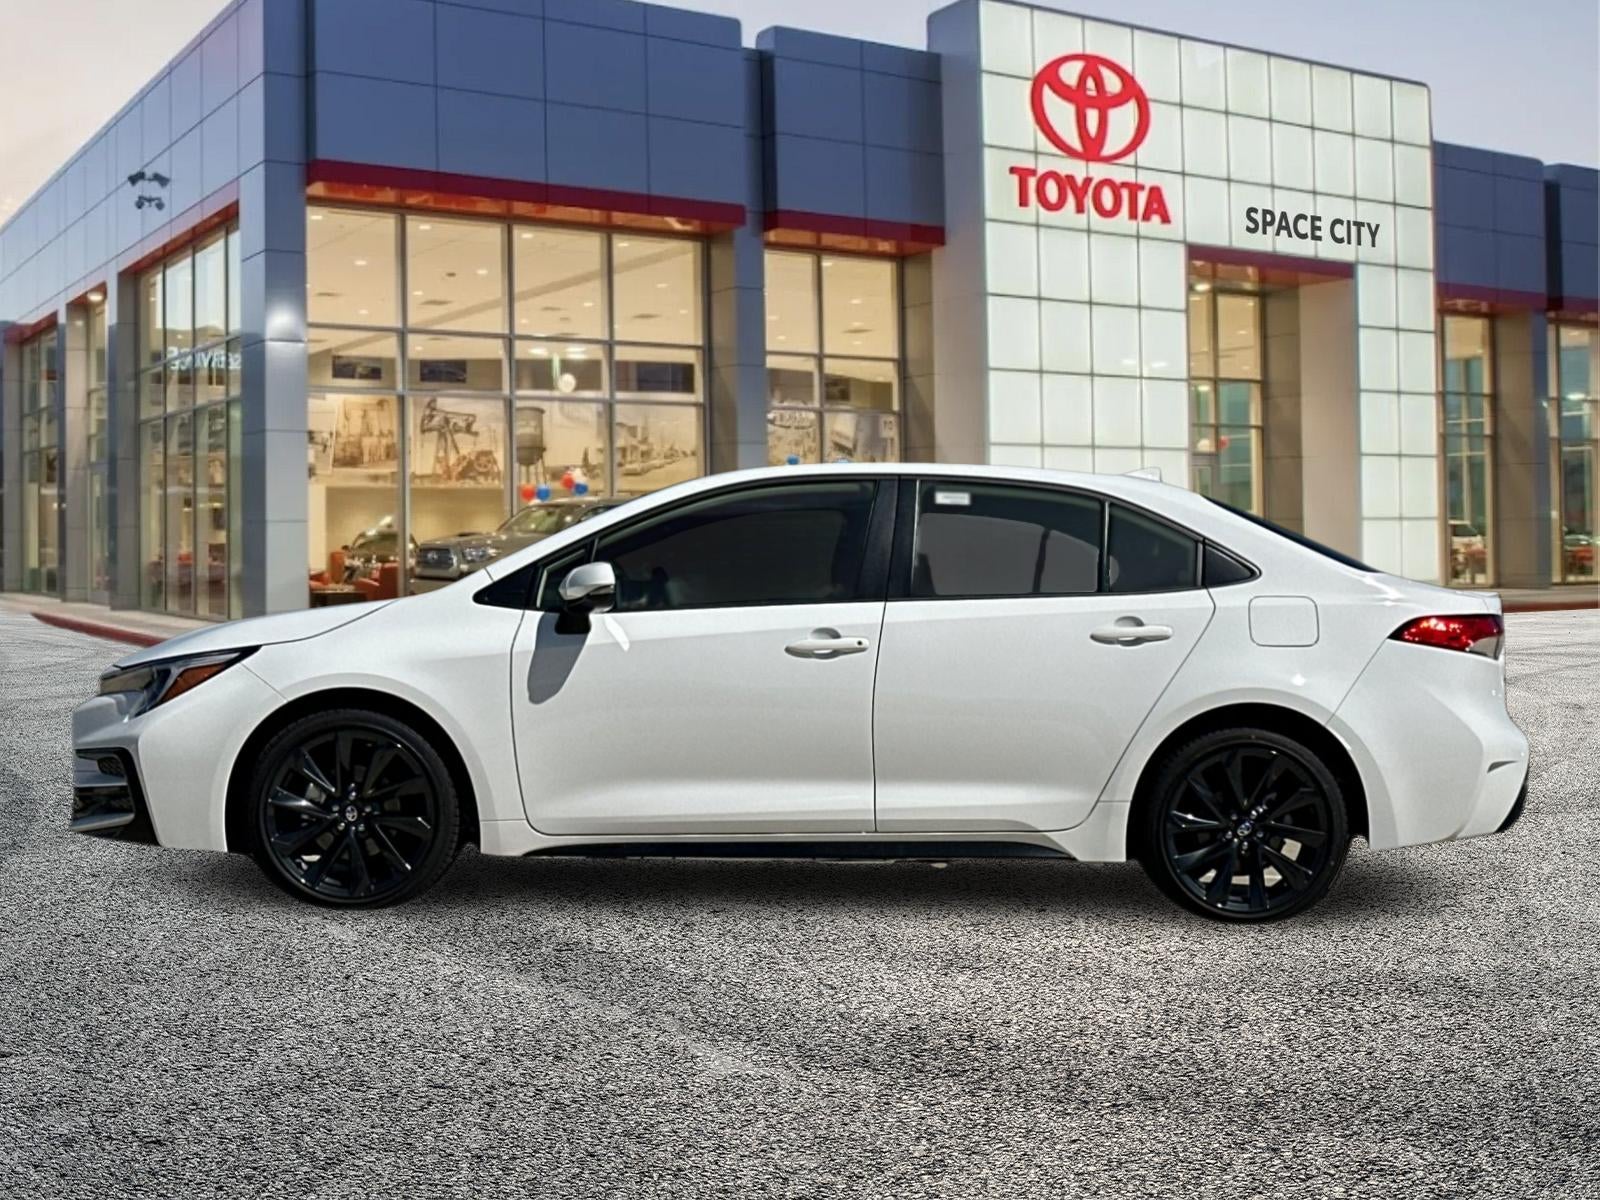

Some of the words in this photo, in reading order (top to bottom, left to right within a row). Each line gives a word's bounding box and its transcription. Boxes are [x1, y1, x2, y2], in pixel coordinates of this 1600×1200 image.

[1010, 166, 1170, 224] TOYOTA
[1246, 206, 1322, 242] SPACE
[1329, 217, 1380, 248] CITY
